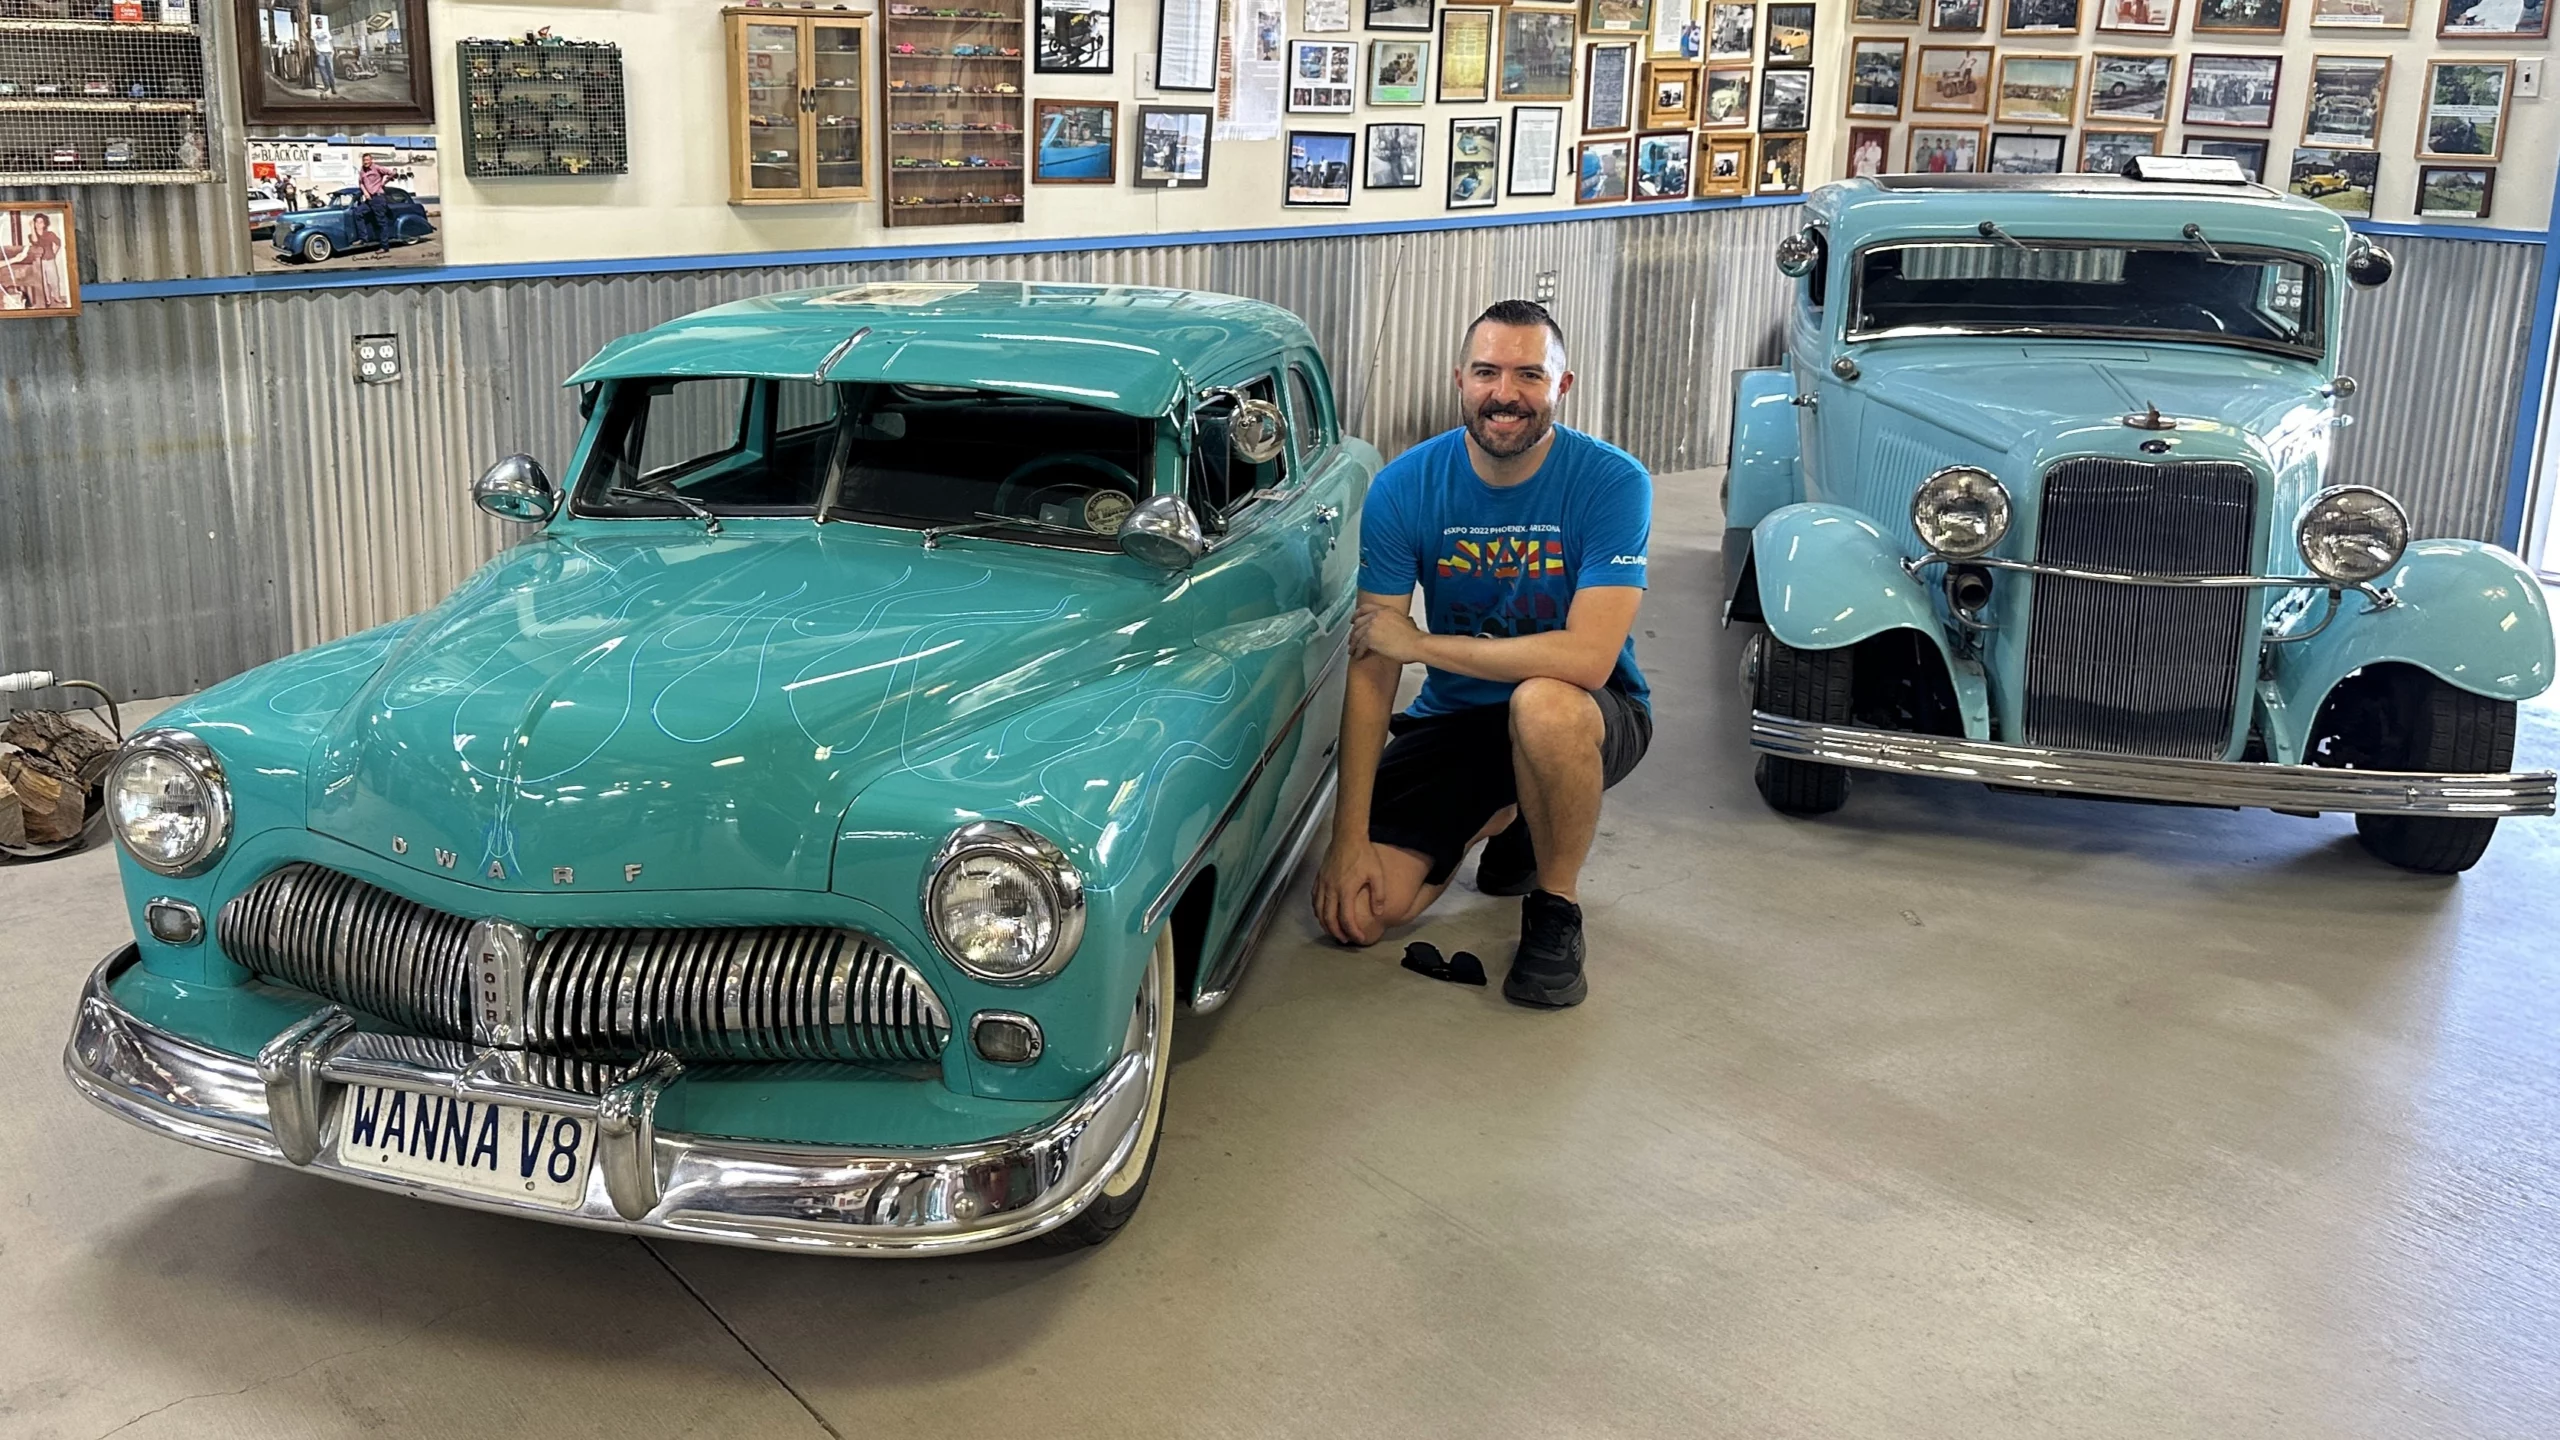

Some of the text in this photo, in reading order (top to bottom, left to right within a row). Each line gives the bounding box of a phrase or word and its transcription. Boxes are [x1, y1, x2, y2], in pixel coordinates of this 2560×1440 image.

[1220, 35, 1232, 73] ARIZONA
[1219, 76, 1231, 119] AWESOME
[261, 149, 292, 161] BLACK
[293, 149, 309, 161] CAT
[1469, 526, 1489, 535] 2022
[1529, 524, 1561, 533] ARIZONA
[391, 834, 643, 885] DWARF
[482, 952, 498, 1023] FOUR
[351, 1085, 582, 1184] WANNA V8
